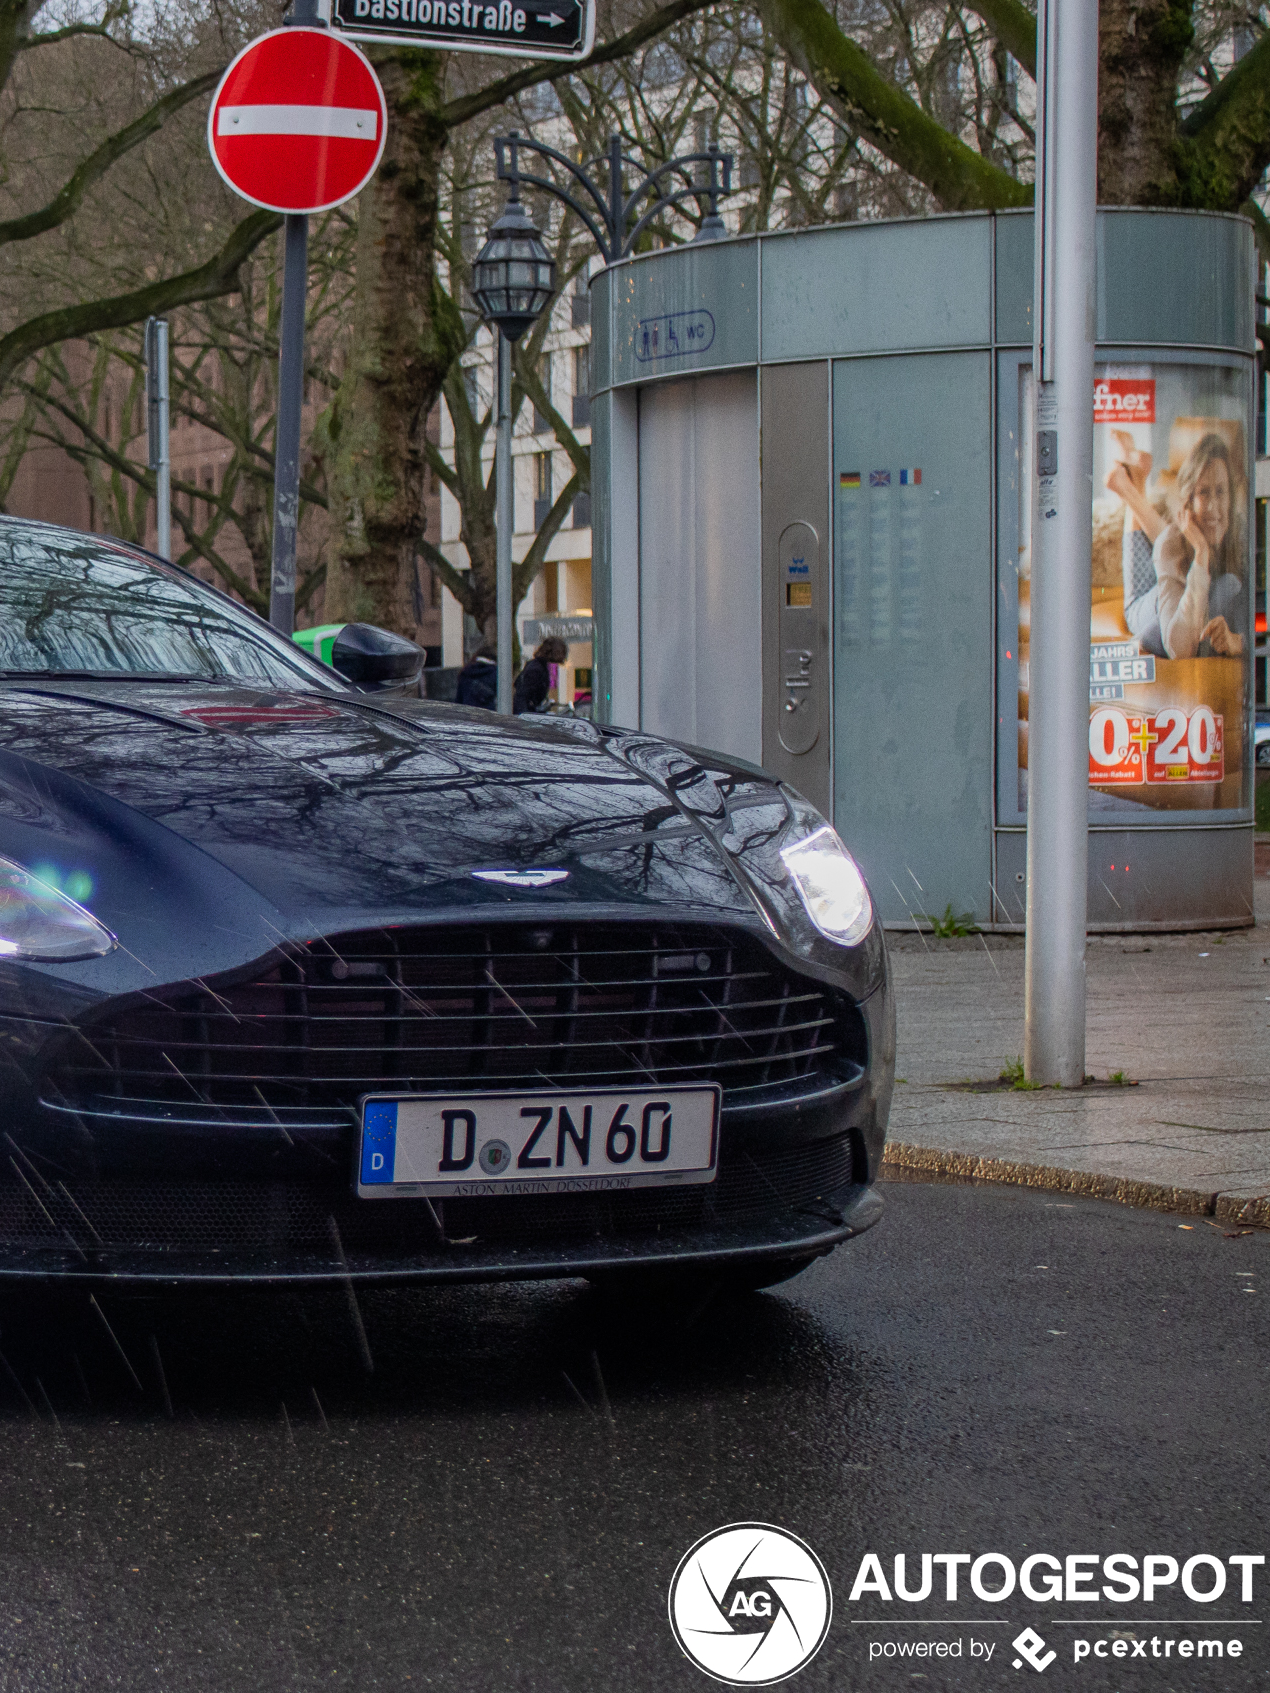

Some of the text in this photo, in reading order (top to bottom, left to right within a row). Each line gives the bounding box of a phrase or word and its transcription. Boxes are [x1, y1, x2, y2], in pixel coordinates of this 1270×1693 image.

[687, 324, 704, 339] WC
[1093, 384, 1150, 411] fner
[1090, 661, 1148, 682] LLER
[439, 1101, 672, 1172] D ZN 60
[371, 1153, 384, 1170] D
[453, 1184, 495, 1196] ASTON
[503, 1181, 550, 1194] MARTIN
